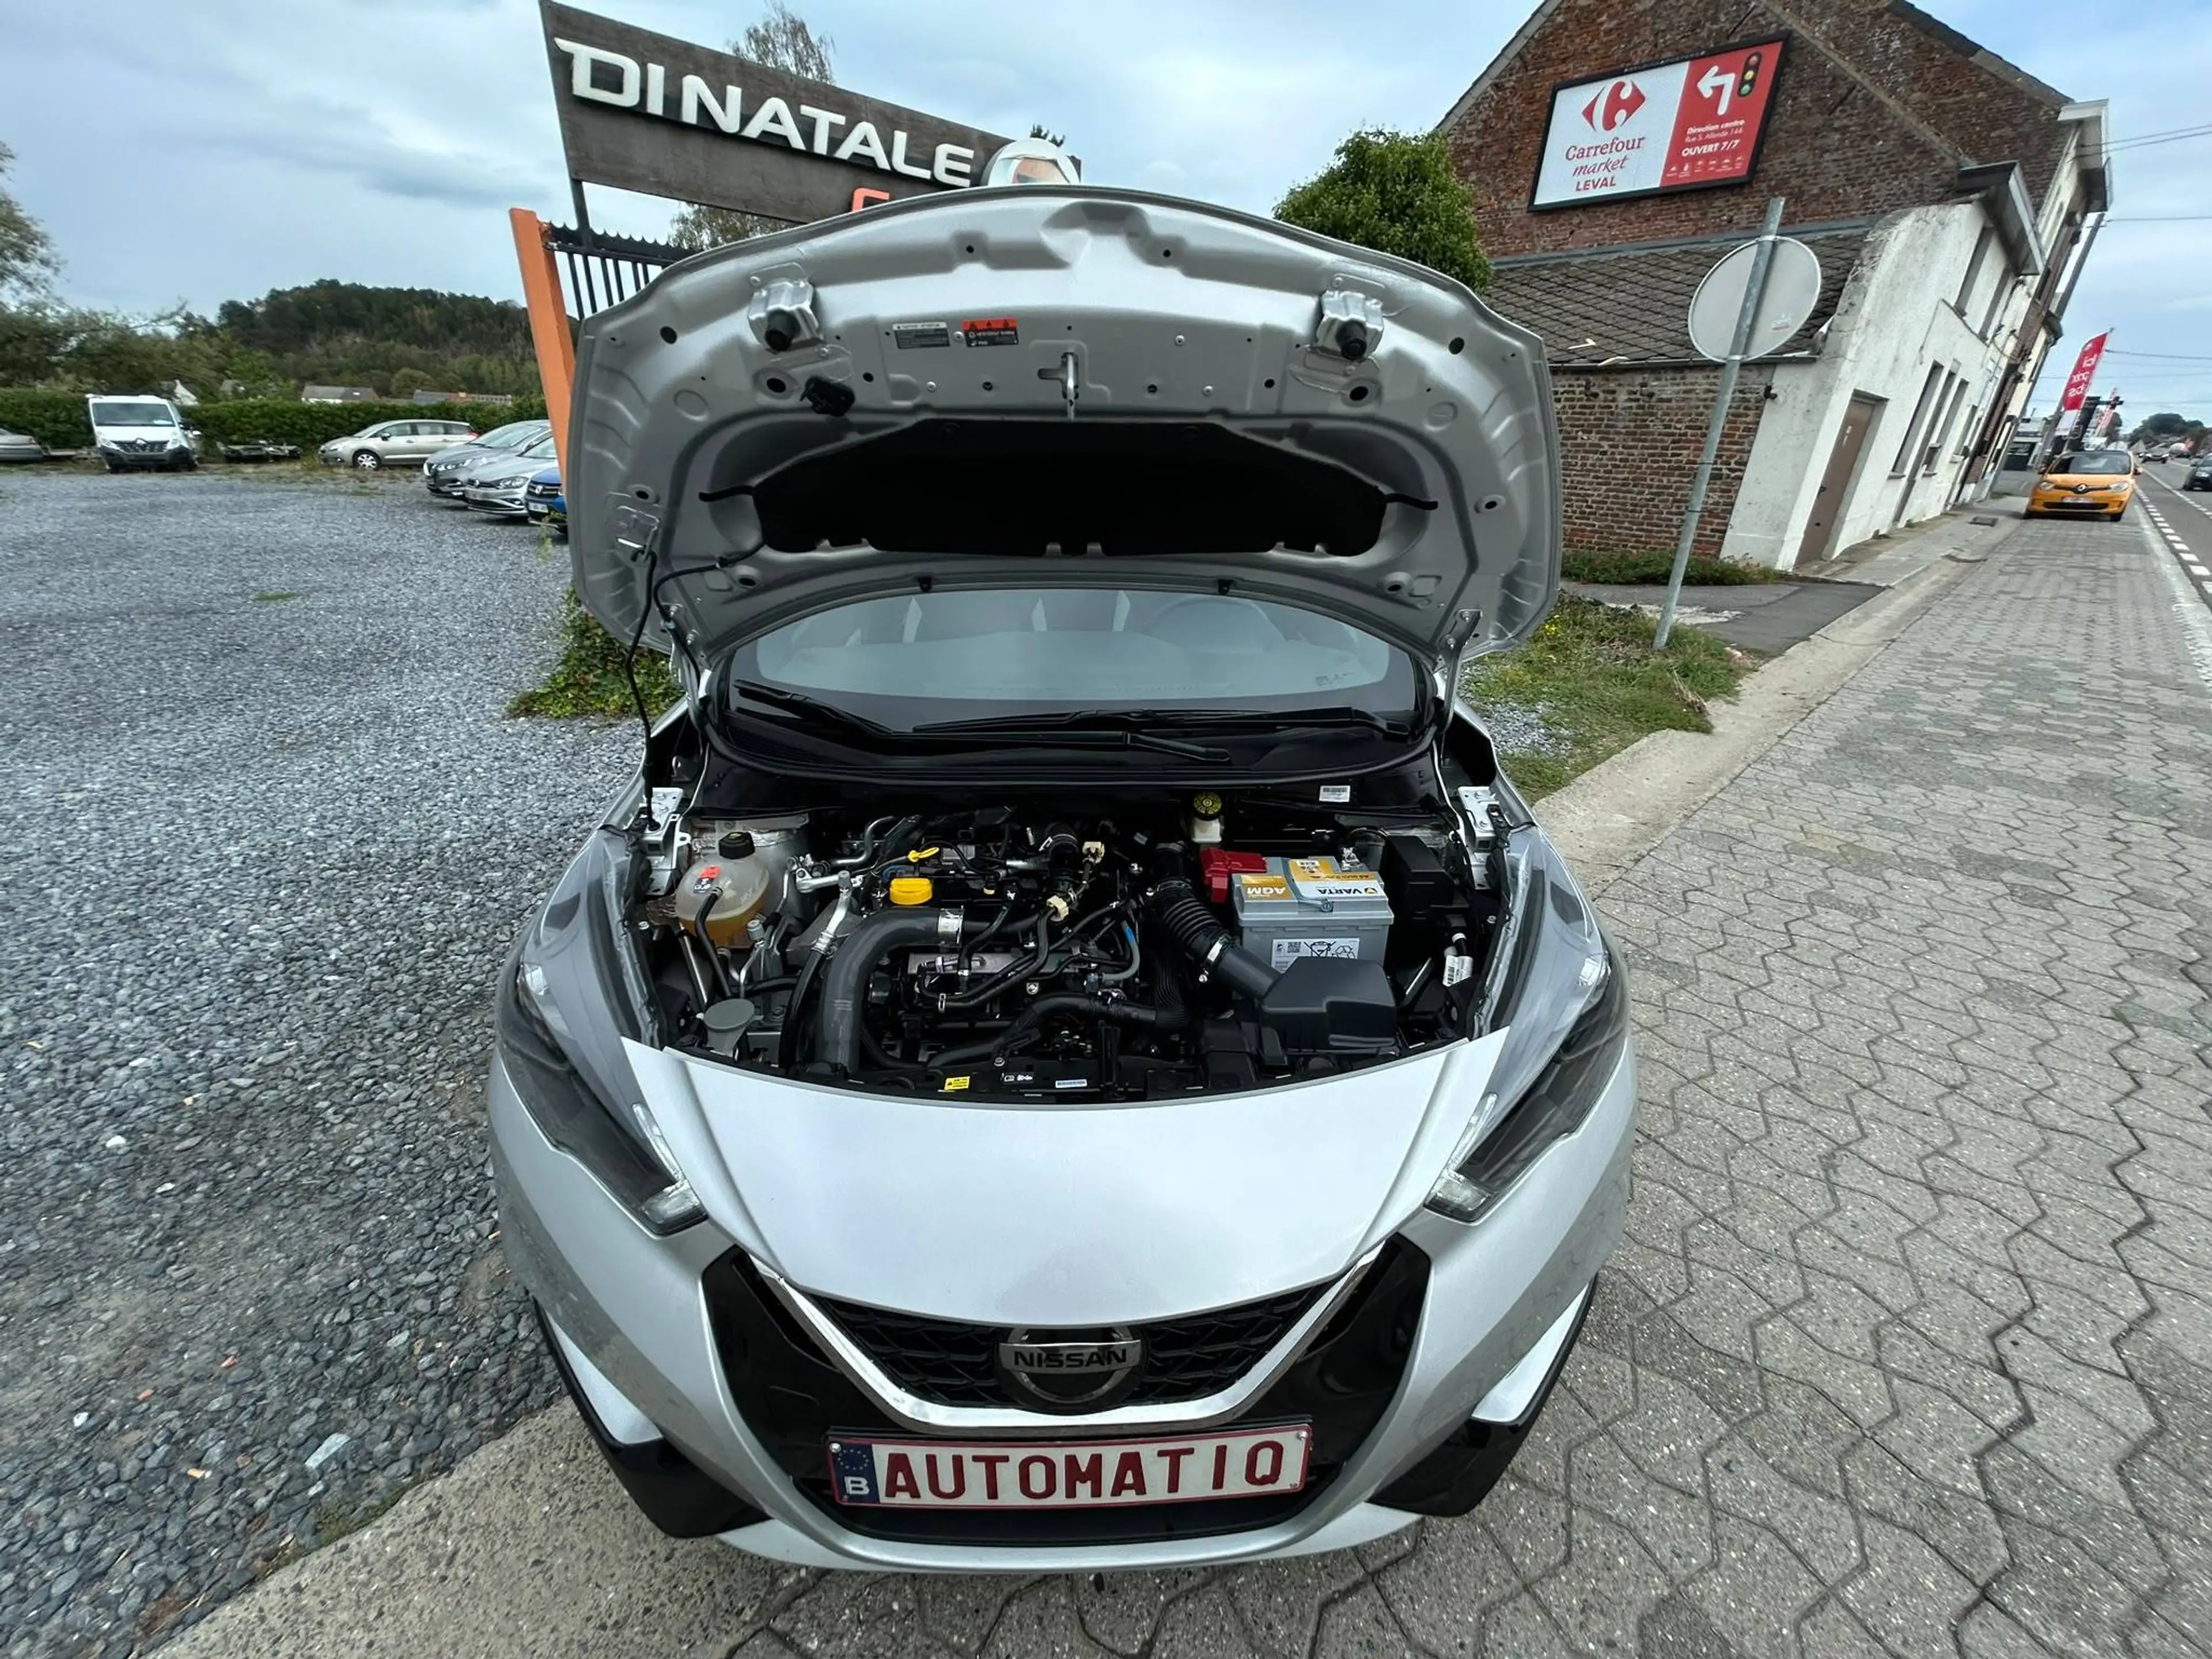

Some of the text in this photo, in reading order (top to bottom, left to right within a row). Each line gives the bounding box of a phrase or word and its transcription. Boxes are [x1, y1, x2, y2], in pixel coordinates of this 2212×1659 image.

[554, 37, 974, 187] DI NATALE
[1565, 137, 1645, 161] Carrefour
[1681, 139, 1741, 157] OUVERT 7/7
[1573, 156, 1630, 176] market
[1575, 176, 1616, 191] LEVAL
[1247, 887, 1286, 895] AGM
[1014, 1349, 1126, 1368] NISSAN
[844, 1440, 1284, 1500] B AUTOMATIQ
